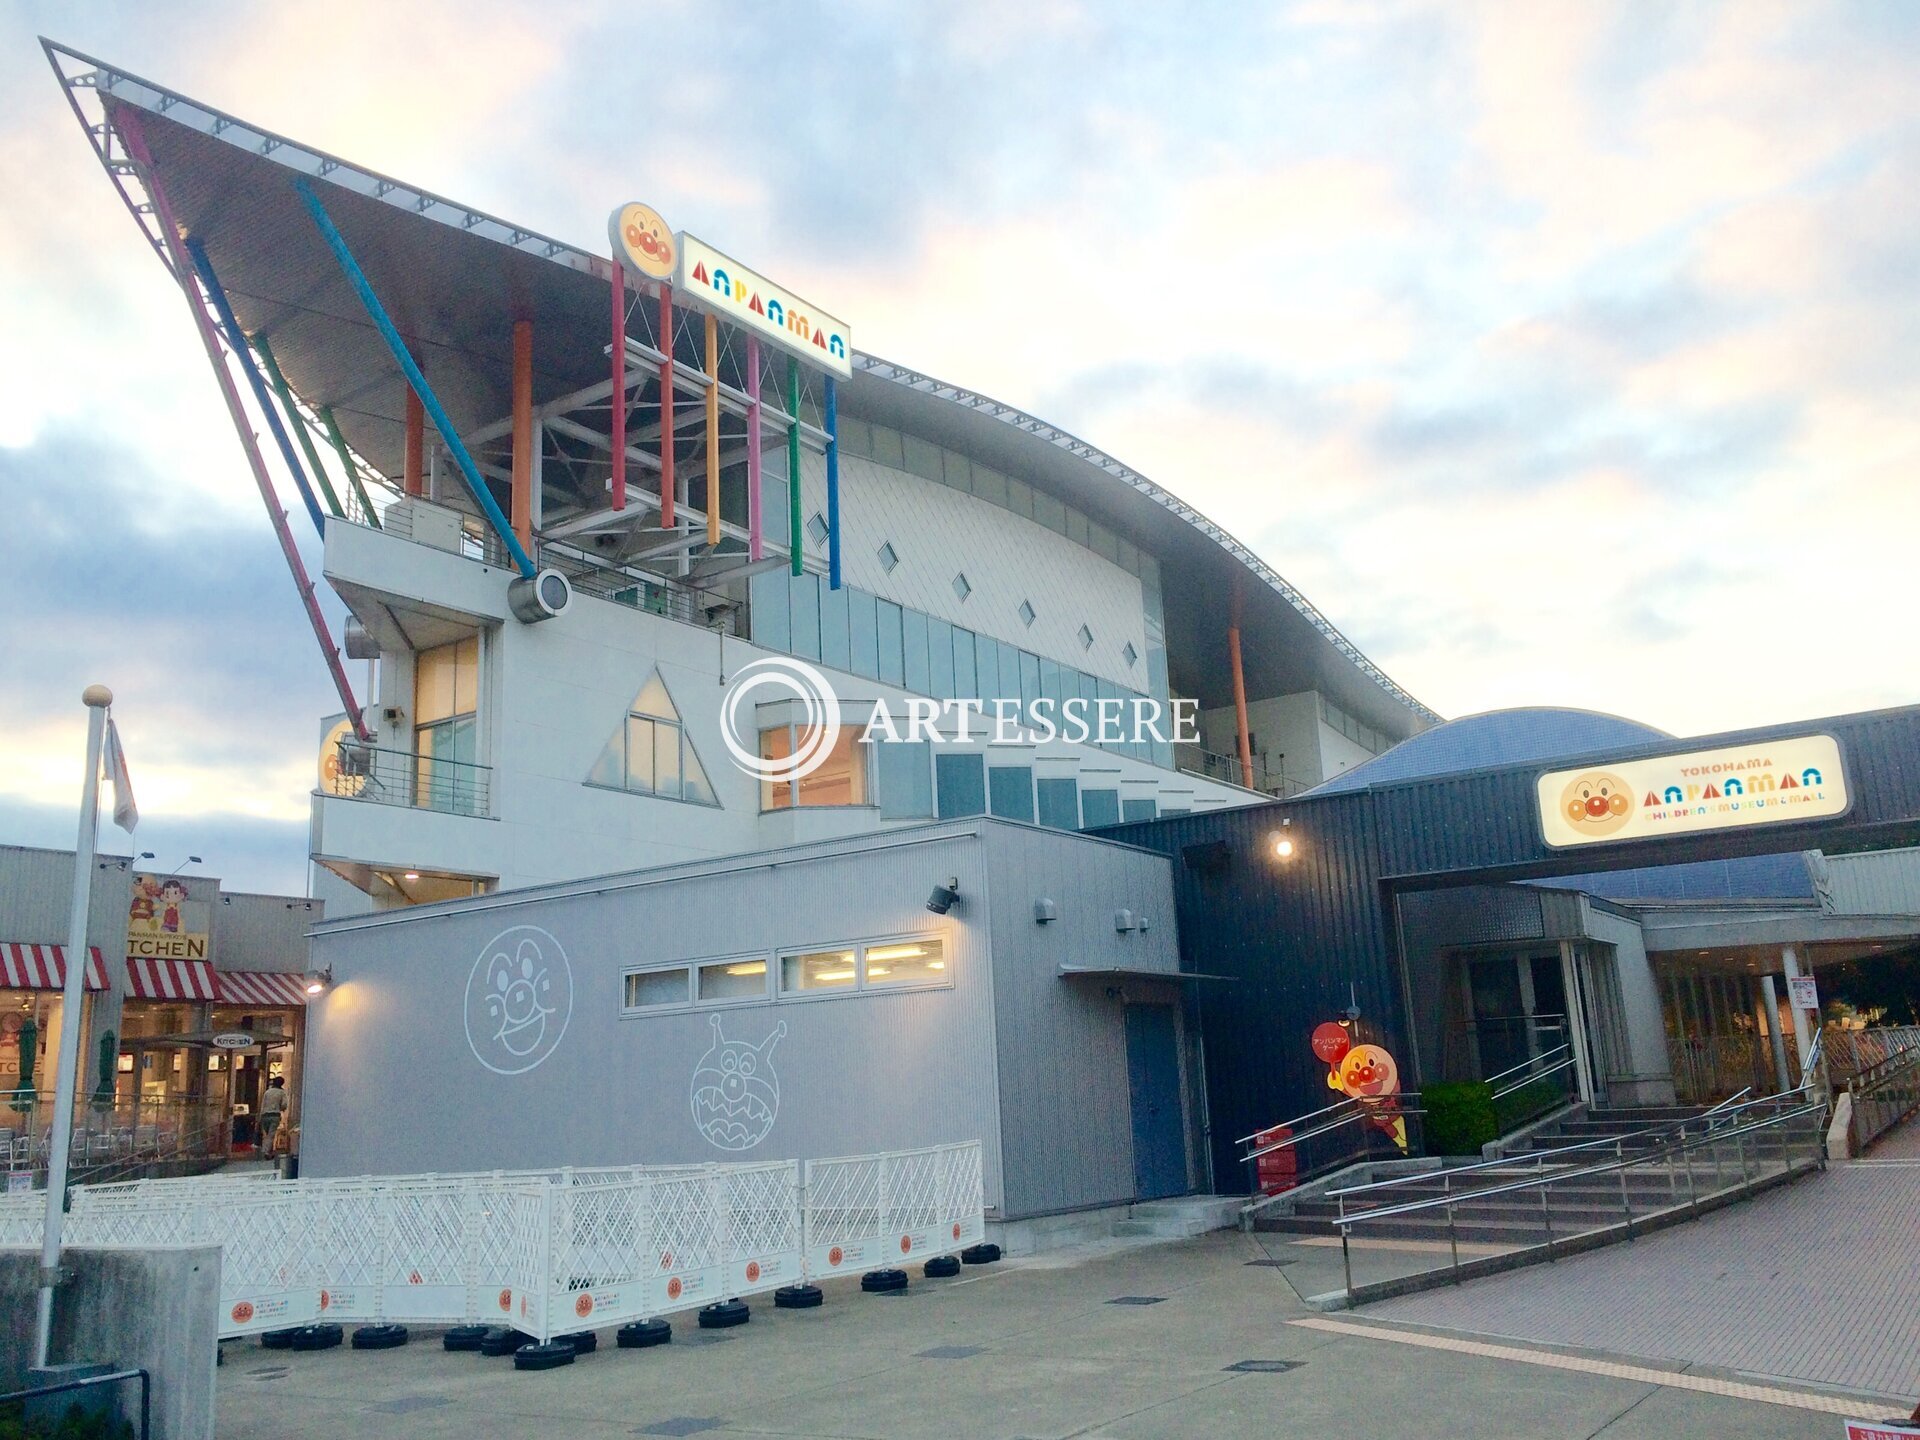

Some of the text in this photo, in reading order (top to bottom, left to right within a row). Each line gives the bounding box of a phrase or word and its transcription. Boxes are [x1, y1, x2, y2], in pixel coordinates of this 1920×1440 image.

[692, 260, 845, 360] ANPANMAN
[1680, 757, 1773, 777] YOKOHAMA
[1643, 767, 1823, 807] ANPANMAN
[1718, 796, 1778, 811] MUSEUM
[1789, 792, 1825, 803] MALL
[128, 939, 204, 958] TCHEN
[1313, 1037, 1347, 1045] アンパンマン
